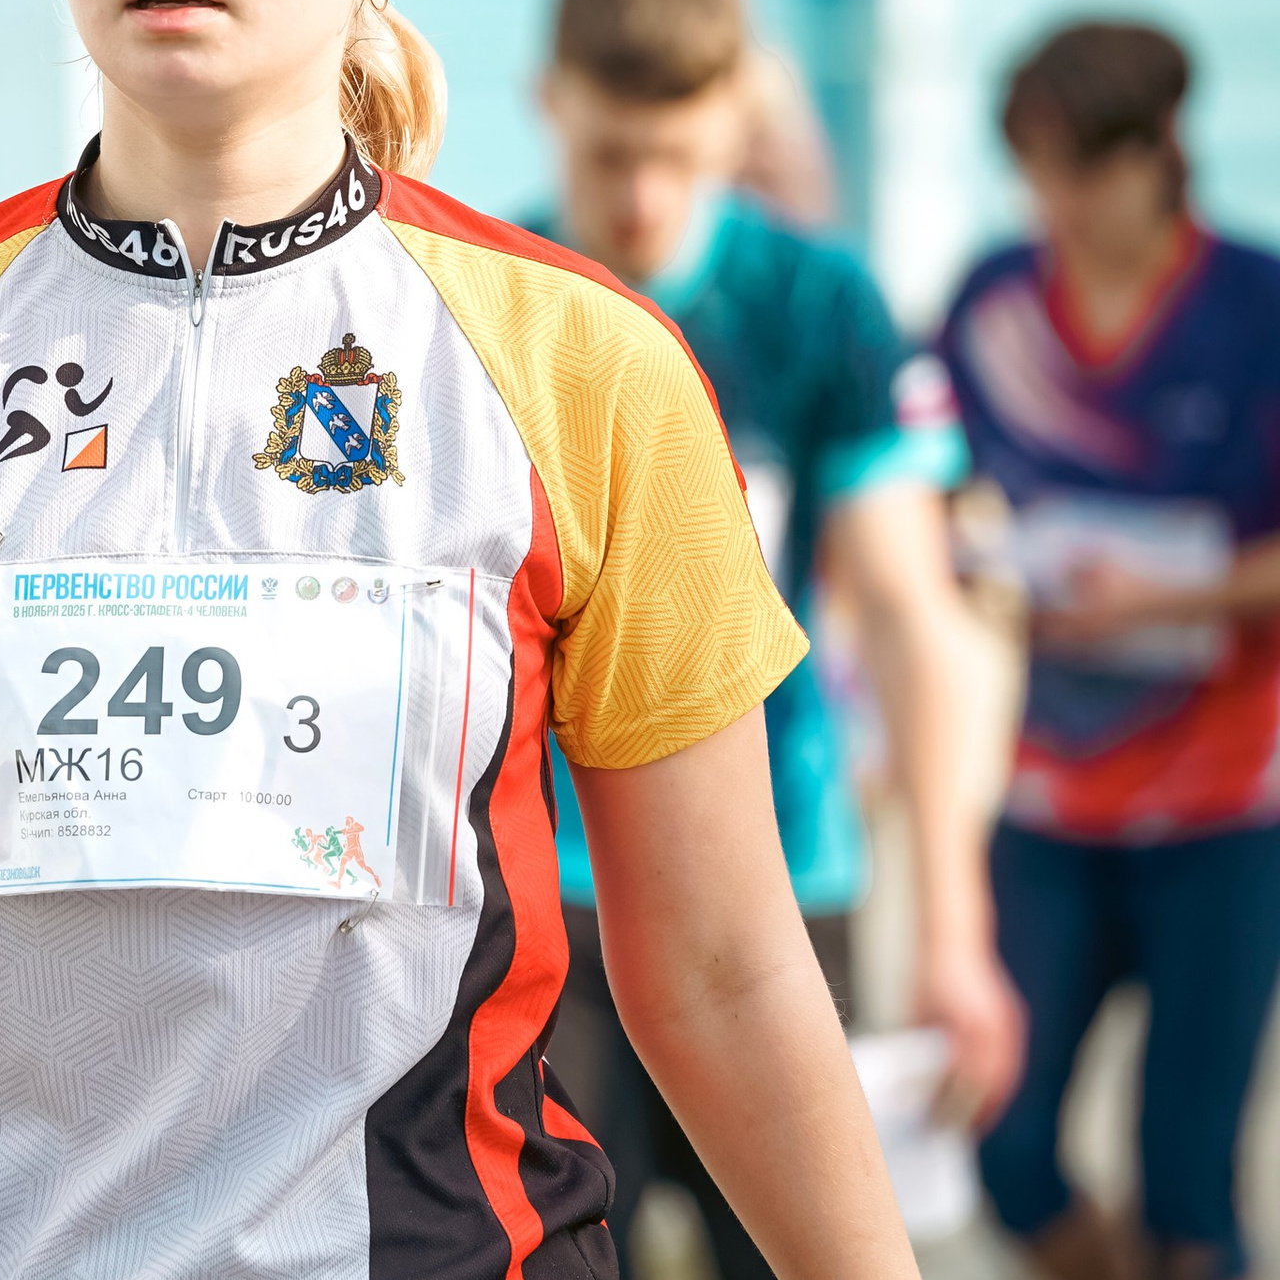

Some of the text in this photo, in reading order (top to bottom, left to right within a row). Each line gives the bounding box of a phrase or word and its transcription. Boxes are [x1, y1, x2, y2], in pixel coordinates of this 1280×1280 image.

[223, 168, 366, 265] RUS46
[14, 572, 249, 601] ПЕРВЕНСТВО РОССИИ
[13, 606, 20, 618] 8
[21, 605, 59, 618] НОЯБРЯ
[61, 604, 86, 617] 2025
[196, 605, 247, 618] ЧЕЛОВЕКА
[36, 646, 242, 736] 249
[283, 695, 322, 754] 3
[15, 747, 144, 784] МЖ16
[19, 789, 128, 803] Емельянова Анна
[240, 791, 292, 806] 10:00:00
[20, 807, 91, 824] Курская обл.
[57, 824, 112, 838] 8528832
